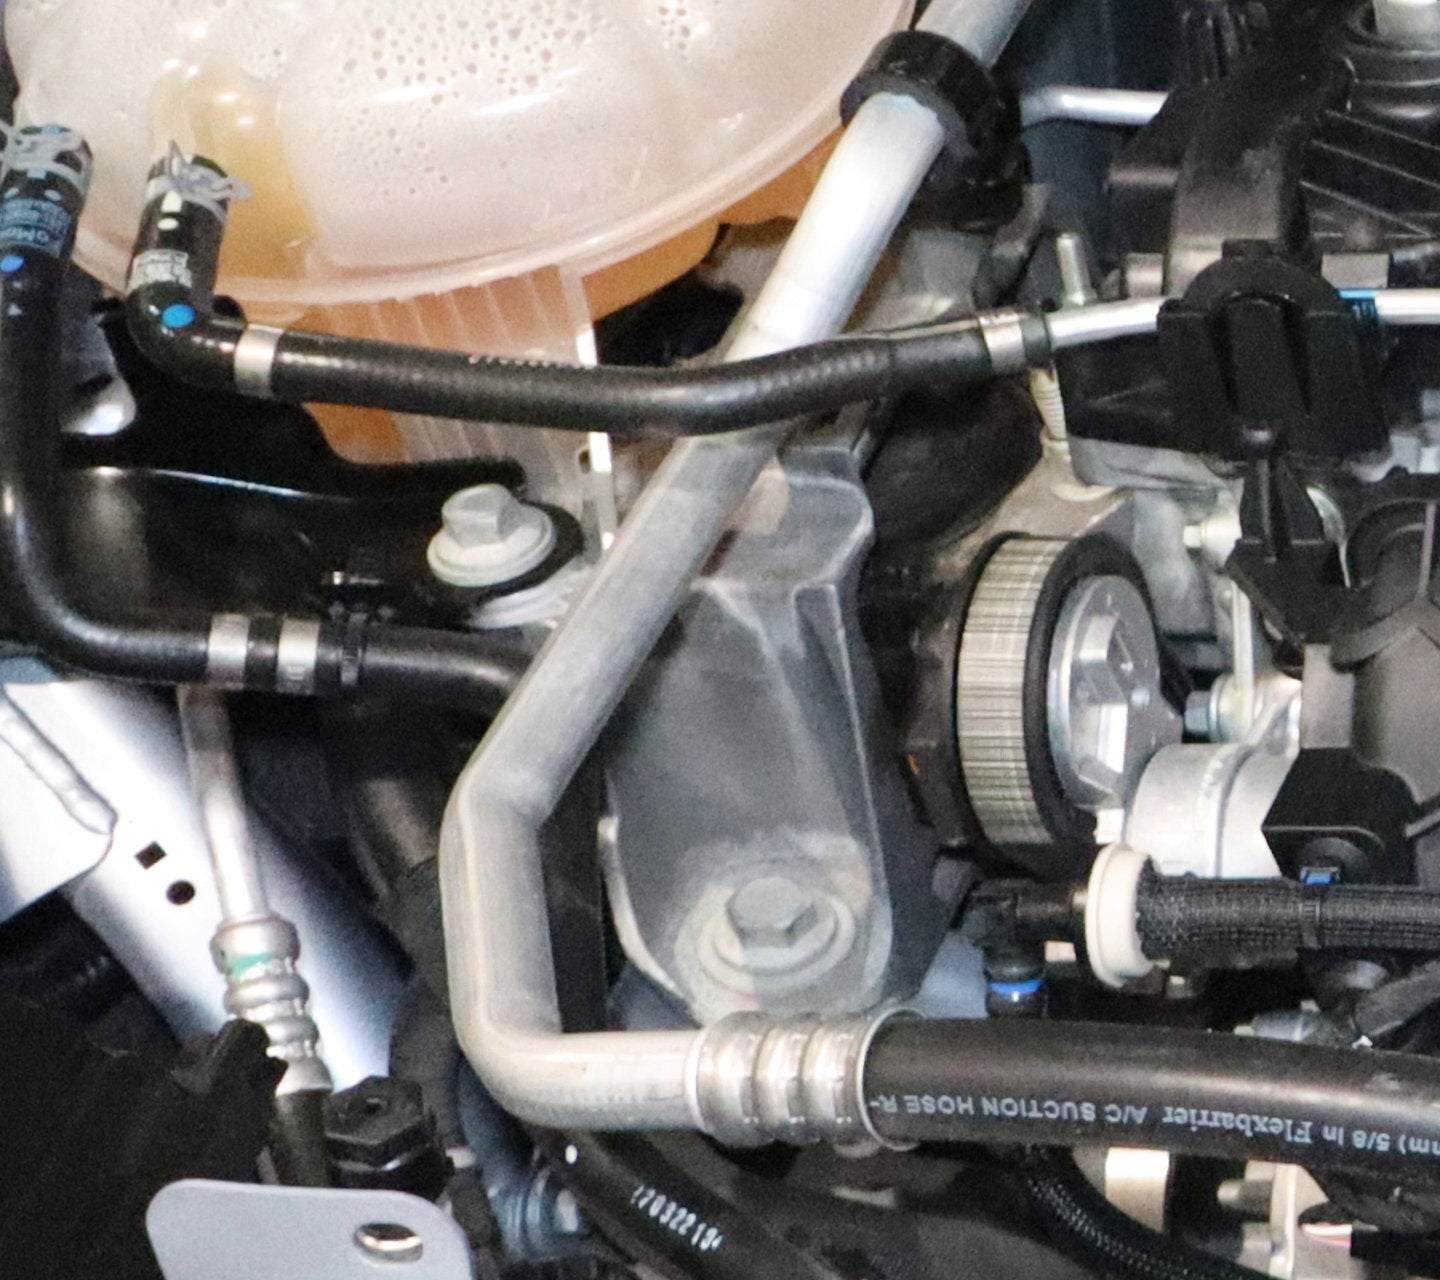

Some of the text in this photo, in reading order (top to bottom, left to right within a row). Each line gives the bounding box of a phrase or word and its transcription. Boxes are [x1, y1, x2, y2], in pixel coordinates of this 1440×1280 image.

[904, 1094, 974, 1117] HOSE
[981, 1095, 1098, 1123] SUCTION
[1104, 1101, 1148, 1126] A/C
[1163, 1104, 1314, 1146] Flexbarrier
[1351, 1128, 1391, 1153] 5/8
